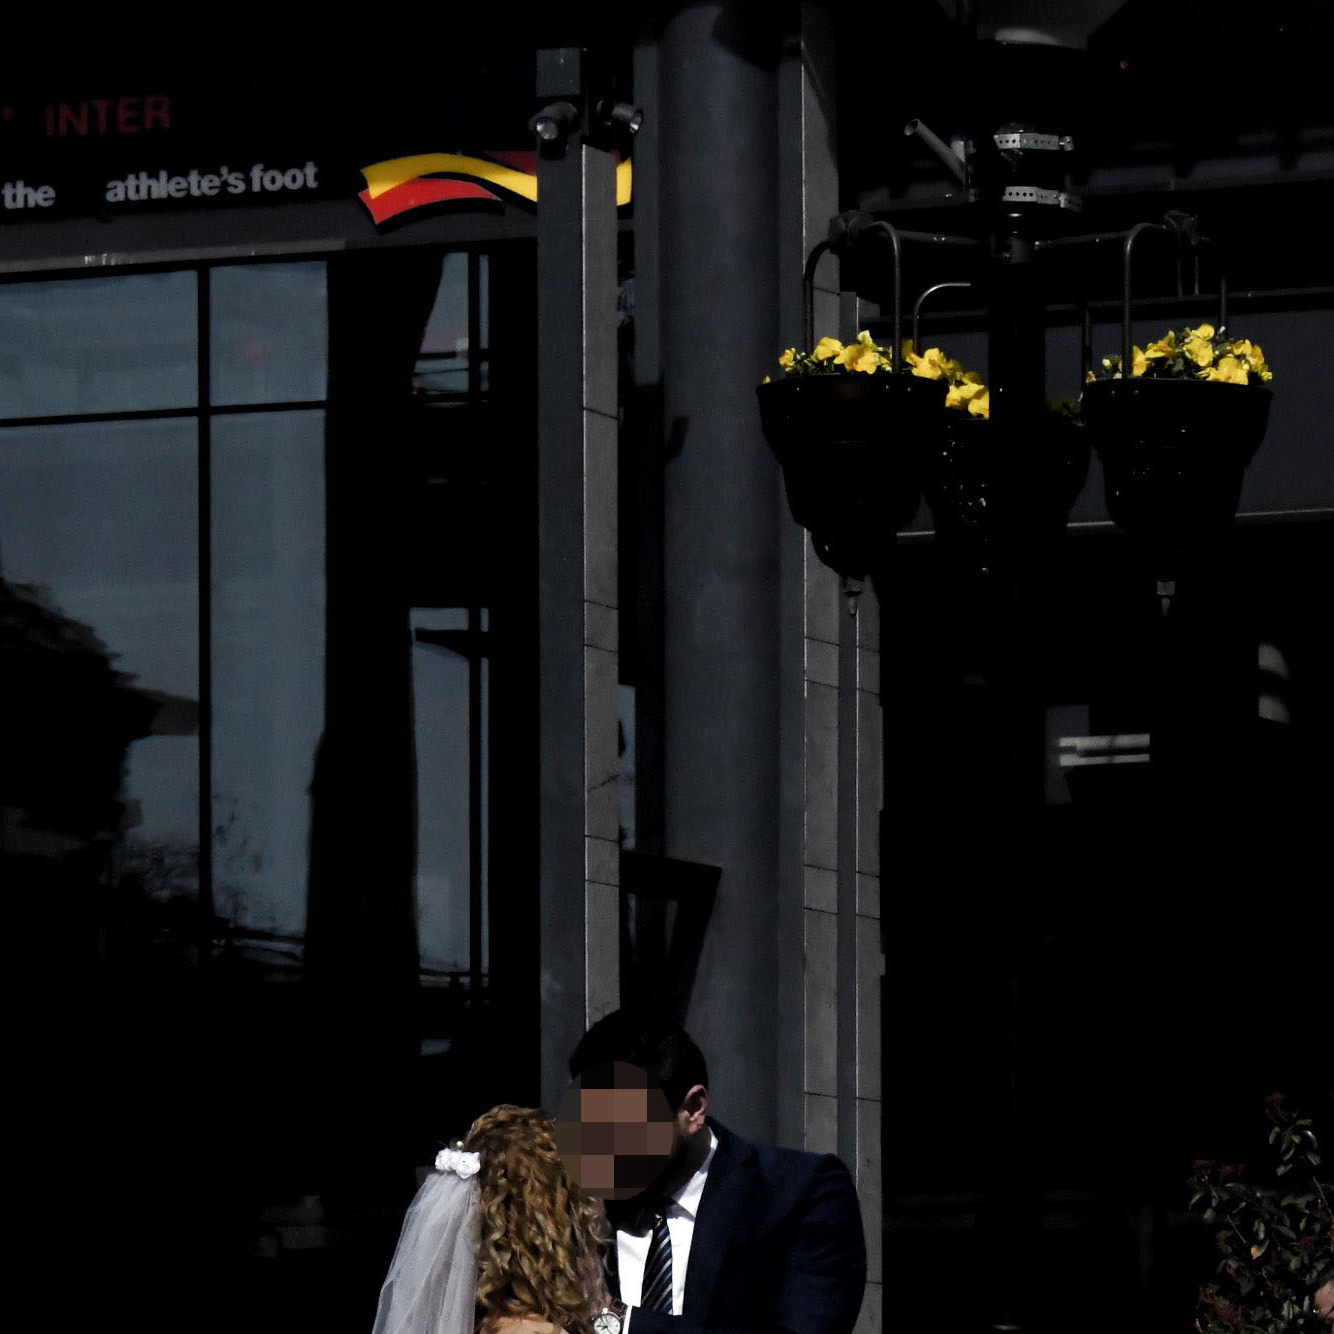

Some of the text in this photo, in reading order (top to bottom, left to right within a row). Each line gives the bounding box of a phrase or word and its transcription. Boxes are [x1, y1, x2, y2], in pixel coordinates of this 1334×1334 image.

[43, 95, 171, 140] INTER
[1, 159, 320, 210] the athlete's foot
